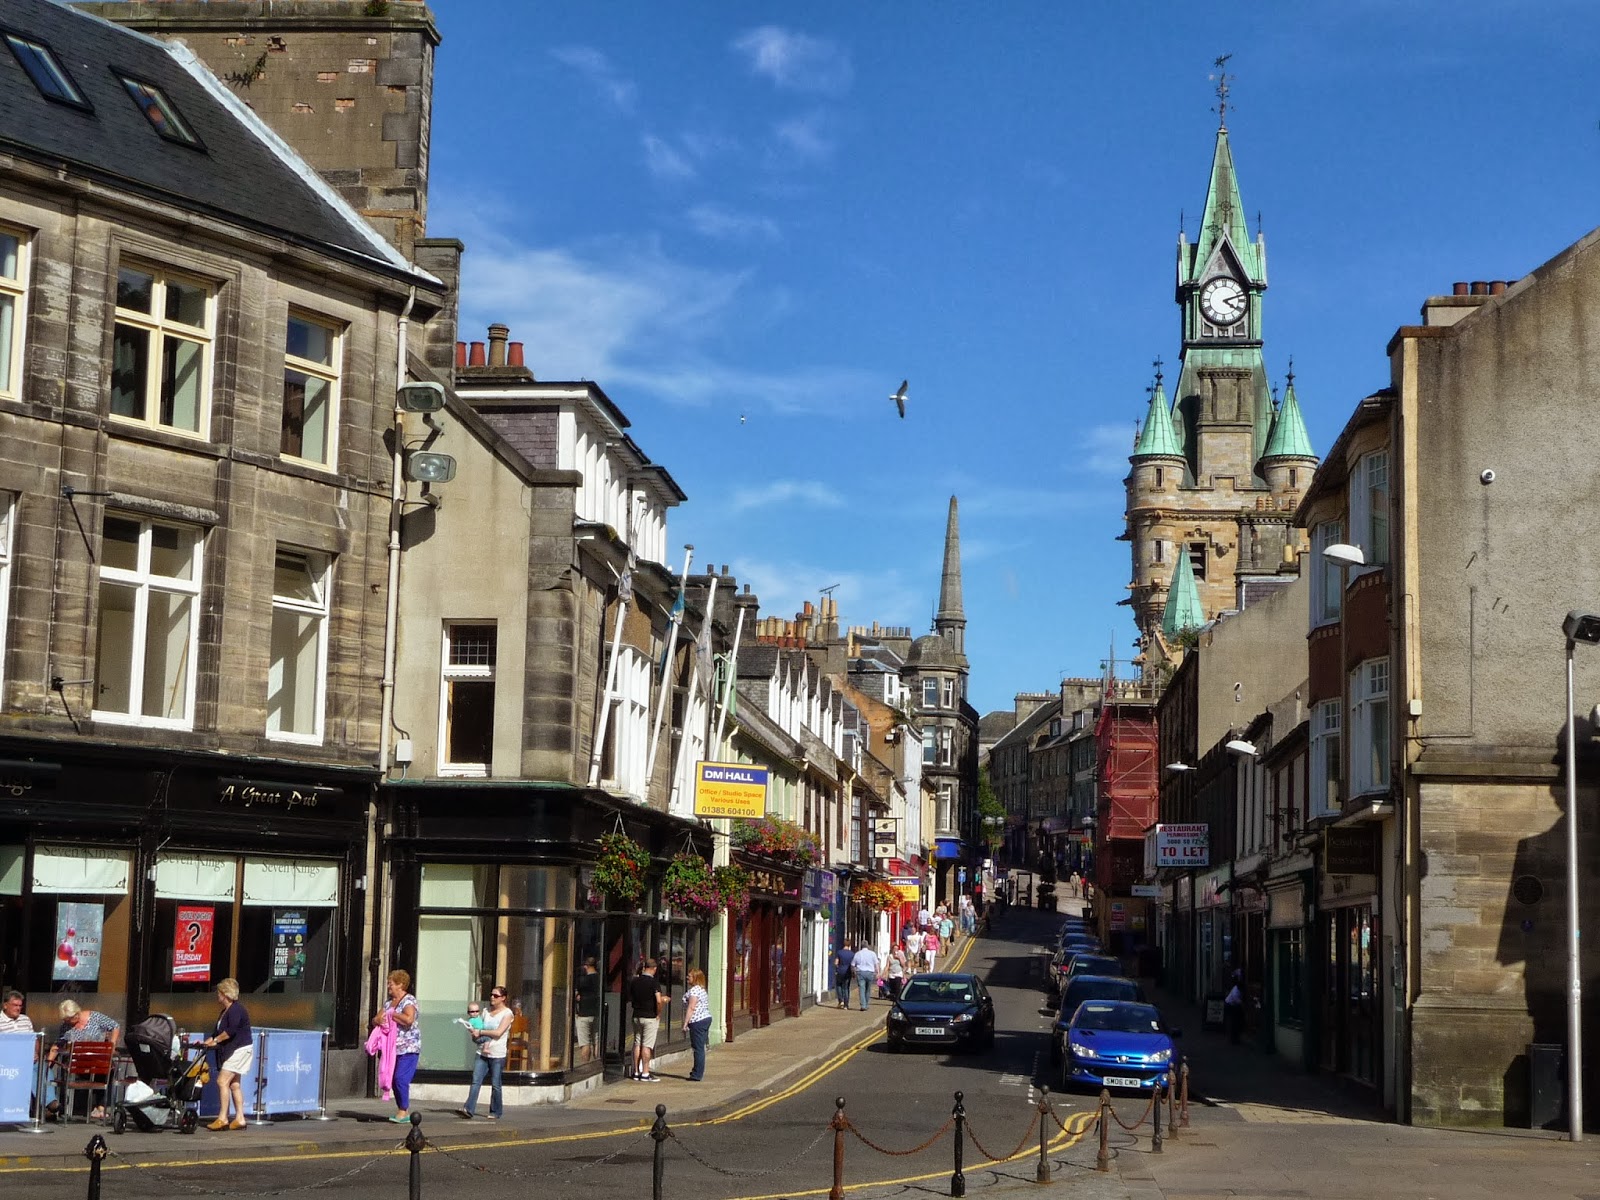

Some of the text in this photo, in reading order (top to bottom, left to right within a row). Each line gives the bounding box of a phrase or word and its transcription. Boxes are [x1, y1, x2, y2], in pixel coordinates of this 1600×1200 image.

[704, 770, 754, 781] DM HALL
[220, 785, 318, 810] A Great Pub
[722, 789, 743, 797] Studio
[743, 791, 763, 799] Space
[710, 796, 734, 804] Various
[701, 805, 756, 816] 01383 604100
[1161, 846, 1206, 857] TO LET
[163, 851, 226, 872] Seven Kings
[261, 860, 320, 878] Seven Kings
[275, 947, 289, 956] FREE
[175, 953, 202, 962] THURSDAY
[274, 956, 289, 965] PINT
[0, 1063, 20, 1080] ings
[276, 1061, 313, 1075] Seven Kings
